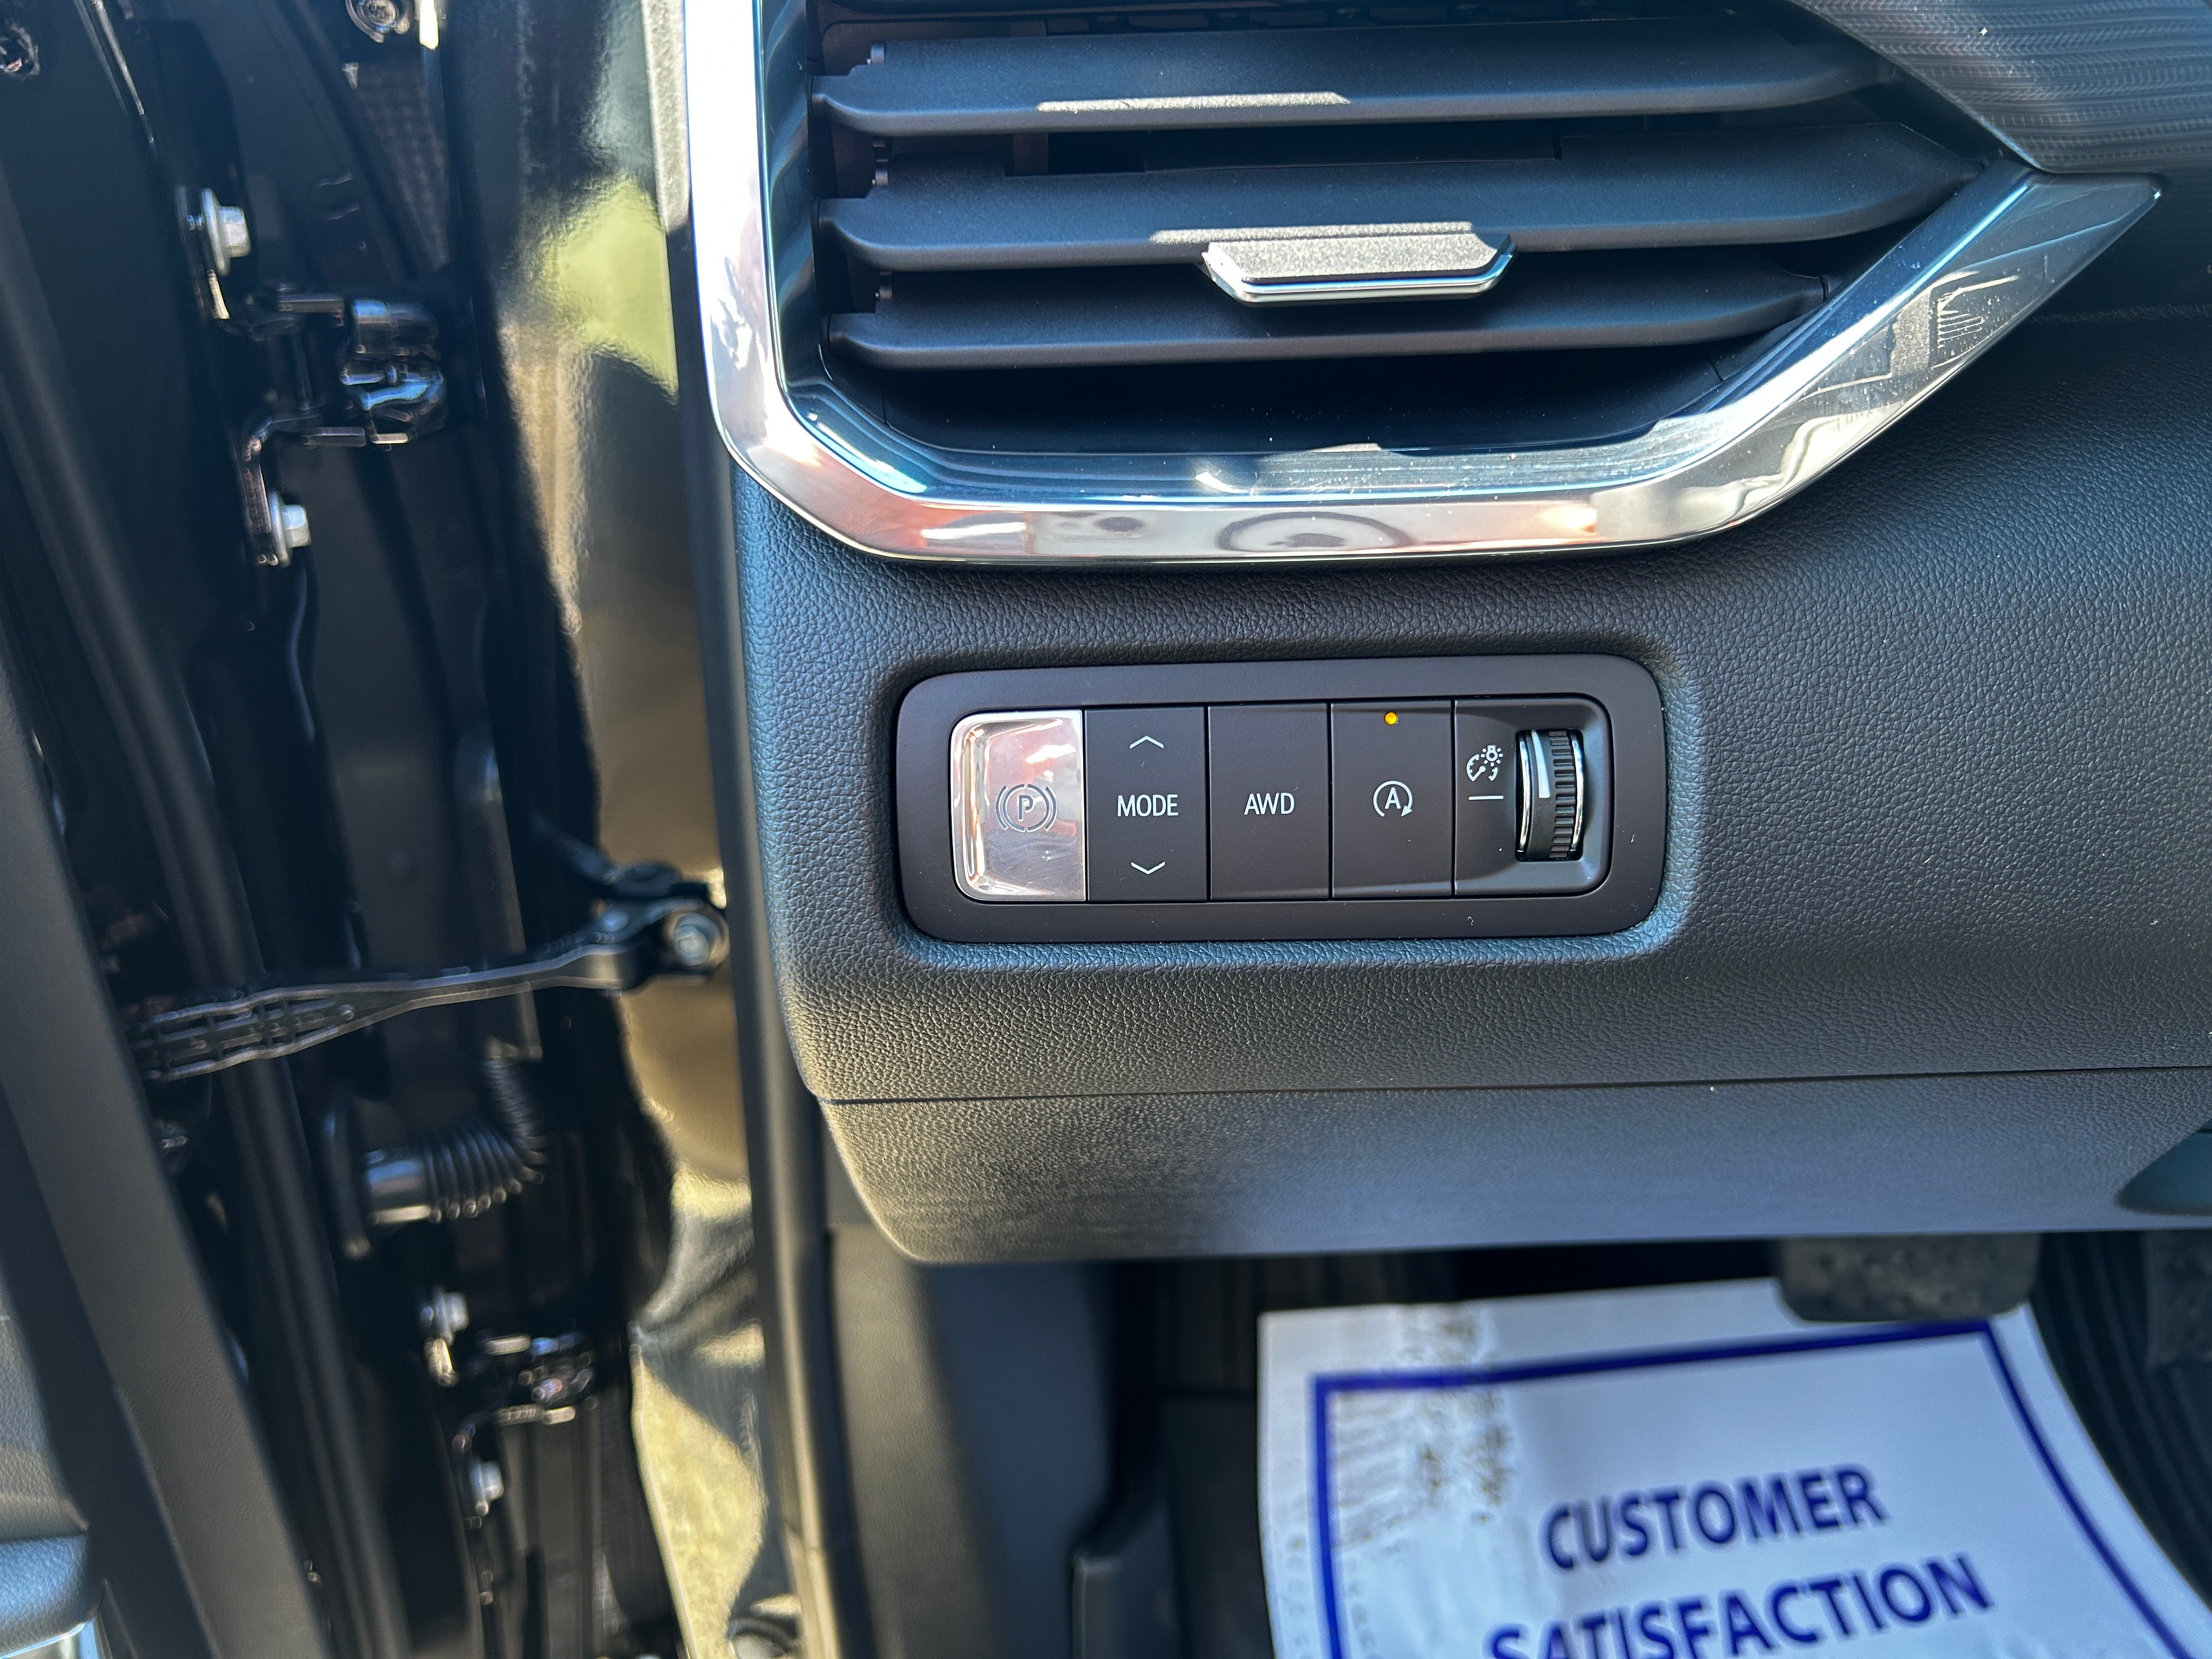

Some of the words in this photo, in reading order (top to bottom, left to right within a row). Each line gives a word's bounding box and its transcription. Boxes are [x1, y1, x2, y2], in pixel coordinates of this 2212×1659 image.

[1018, 795, 1033, 821] P
[1117, 794, 1178, 817] MODE
[1244, 792, 1295, 815] AWD
[1384, 787, 1401, 810] A
[1542, 1465, 1888, 1571] CUSTOMER
